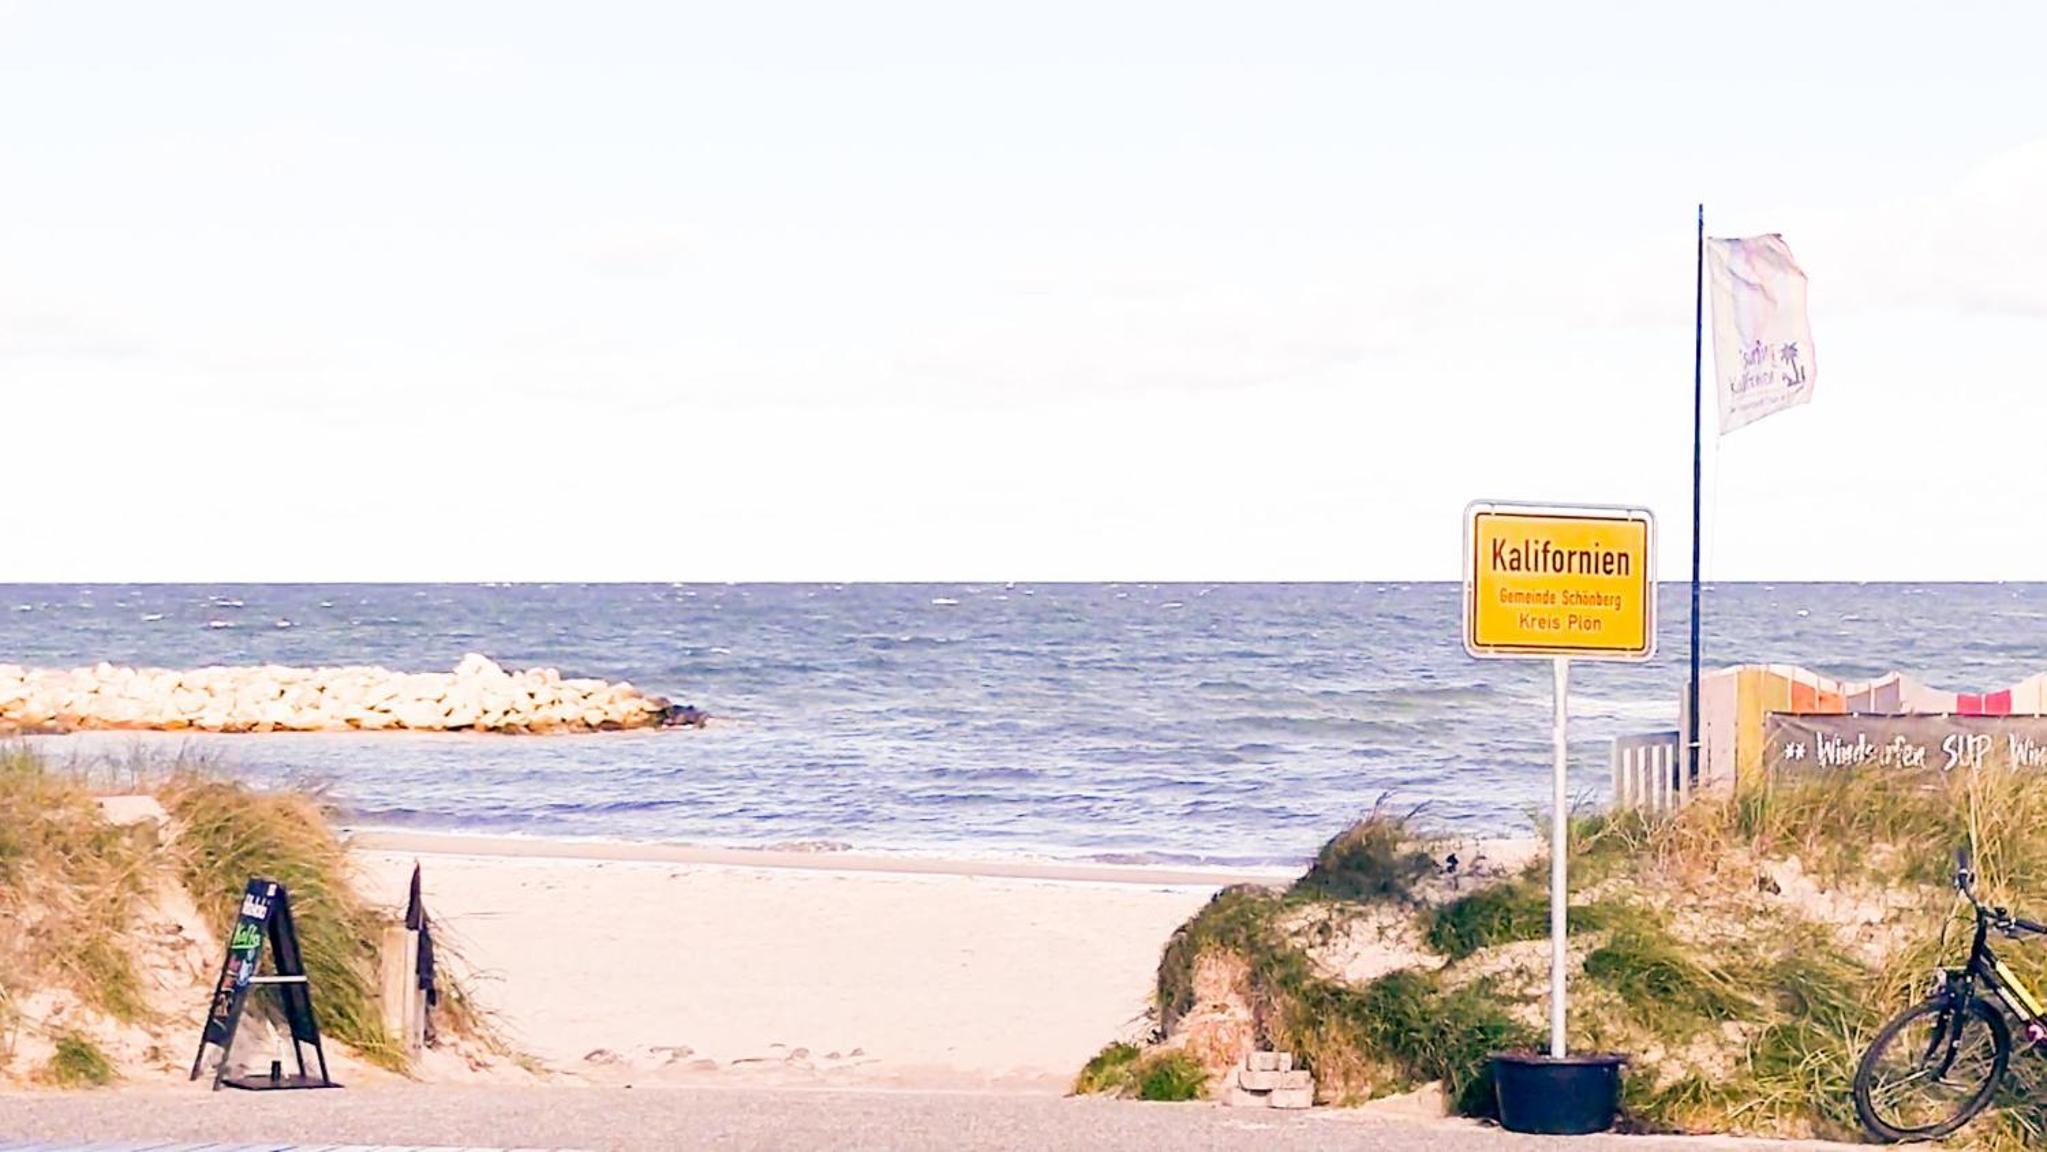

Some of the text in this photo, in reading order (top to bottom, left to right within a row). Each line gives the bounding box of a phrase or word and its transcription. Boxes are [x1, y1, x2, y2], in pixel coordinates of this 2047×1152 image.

[1492, 537, 1630, 576] Kalifornien
[1500, 588, 1556, 605] Gemeinde
[1520, 612, 1561, 630] Kreis
[1942, 734, 1992, 773] SUP
